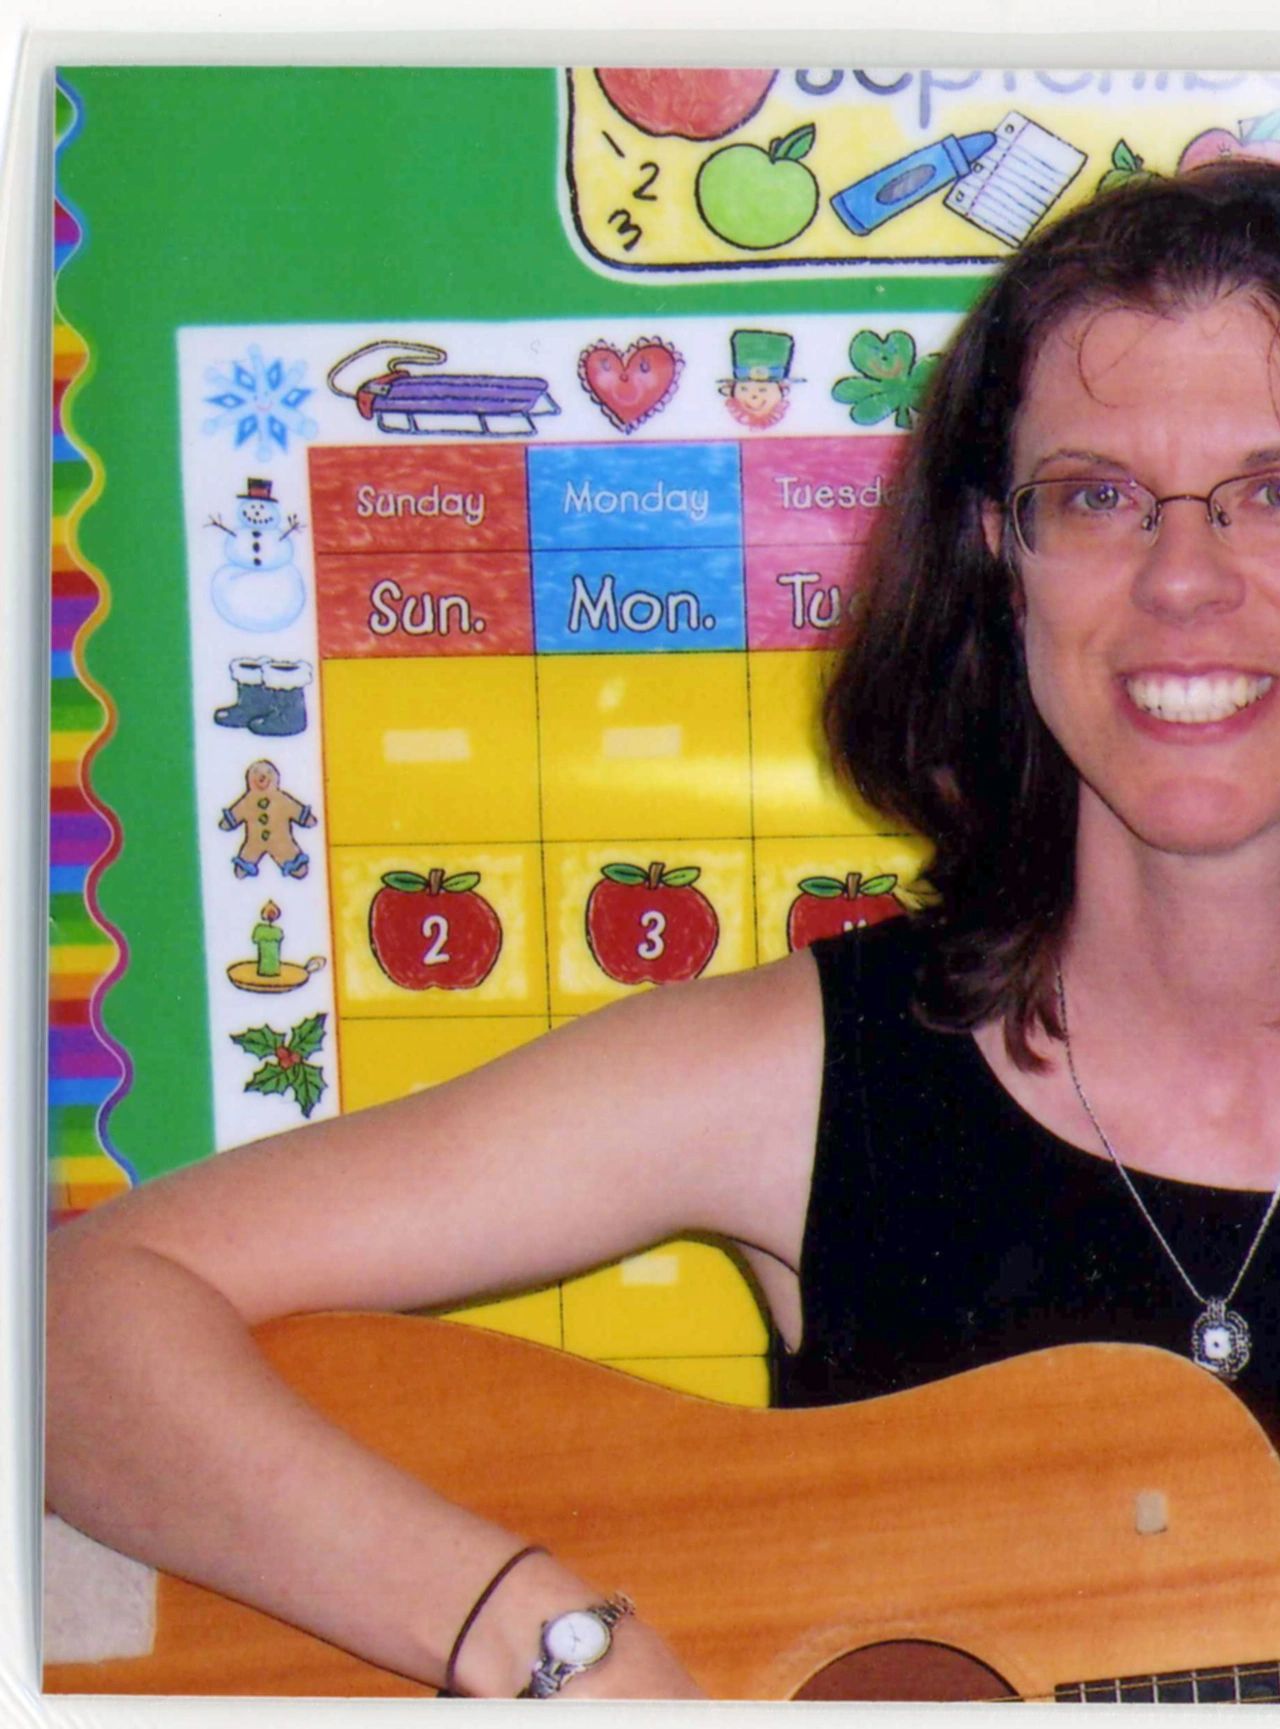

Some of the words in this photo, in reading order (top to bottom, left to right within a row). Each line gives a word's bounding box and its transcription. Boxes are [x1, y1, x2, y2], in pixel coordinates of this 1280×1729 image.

[632, 162, 660, 201] 2
[608, 209, 644, 251] 3
[356, 484, 486, 527] Sunday
[562, 479, 711, 521] Monday
[368, 578, 487, 637] Sun.
[567, 574, 717, 633] Mon.
[421, 914, 451, 966] 2
[636, 909, 667, 961] 3
